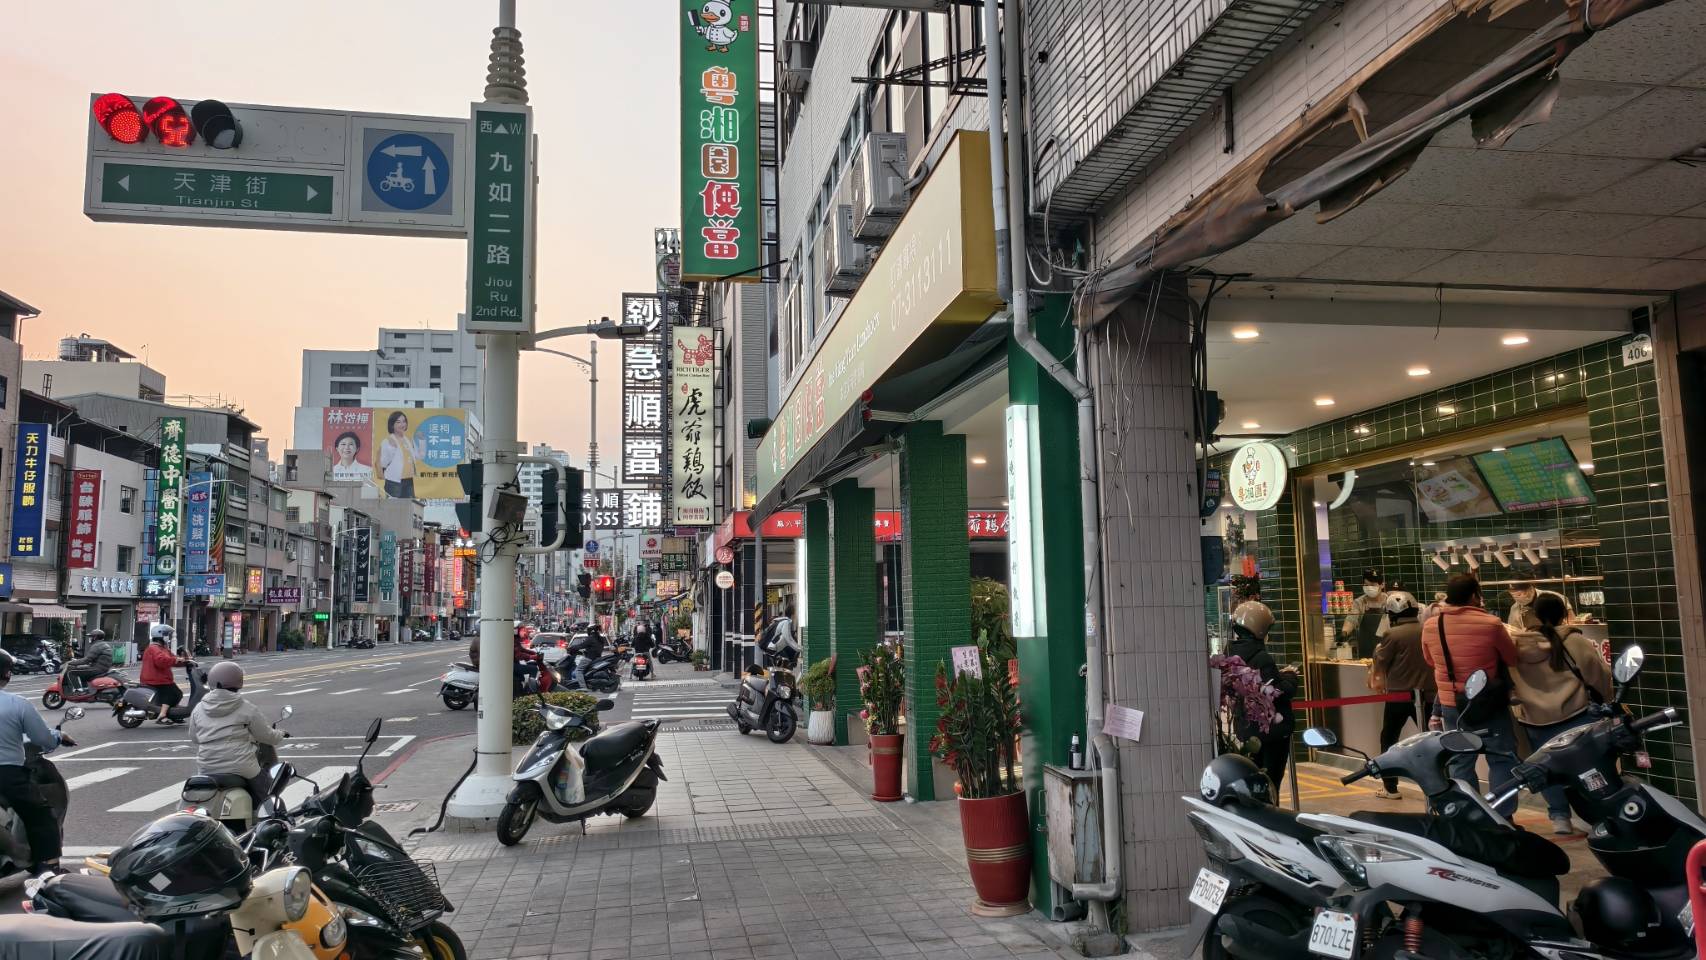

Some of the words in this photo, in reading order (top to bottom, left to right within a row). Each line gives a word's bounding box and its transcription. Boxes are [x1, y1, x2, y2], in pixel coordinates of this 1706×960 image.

[480, 120, 492, 133] 西
[174, 172, 267, 195] 天津街
[176, 195, 235, 208] Tianjin
[241, 199, 258, 208] St
[487, 152, 512, 265] 九如二路
[485, 276, 512, 287] Jiou
[490, 291, 508, 301] Ru
[476, 306, 497, 317] 2nd
[500, 306, 519, 317] Rd.
[626, 297, 662, 527] 鈔急順當鋪
